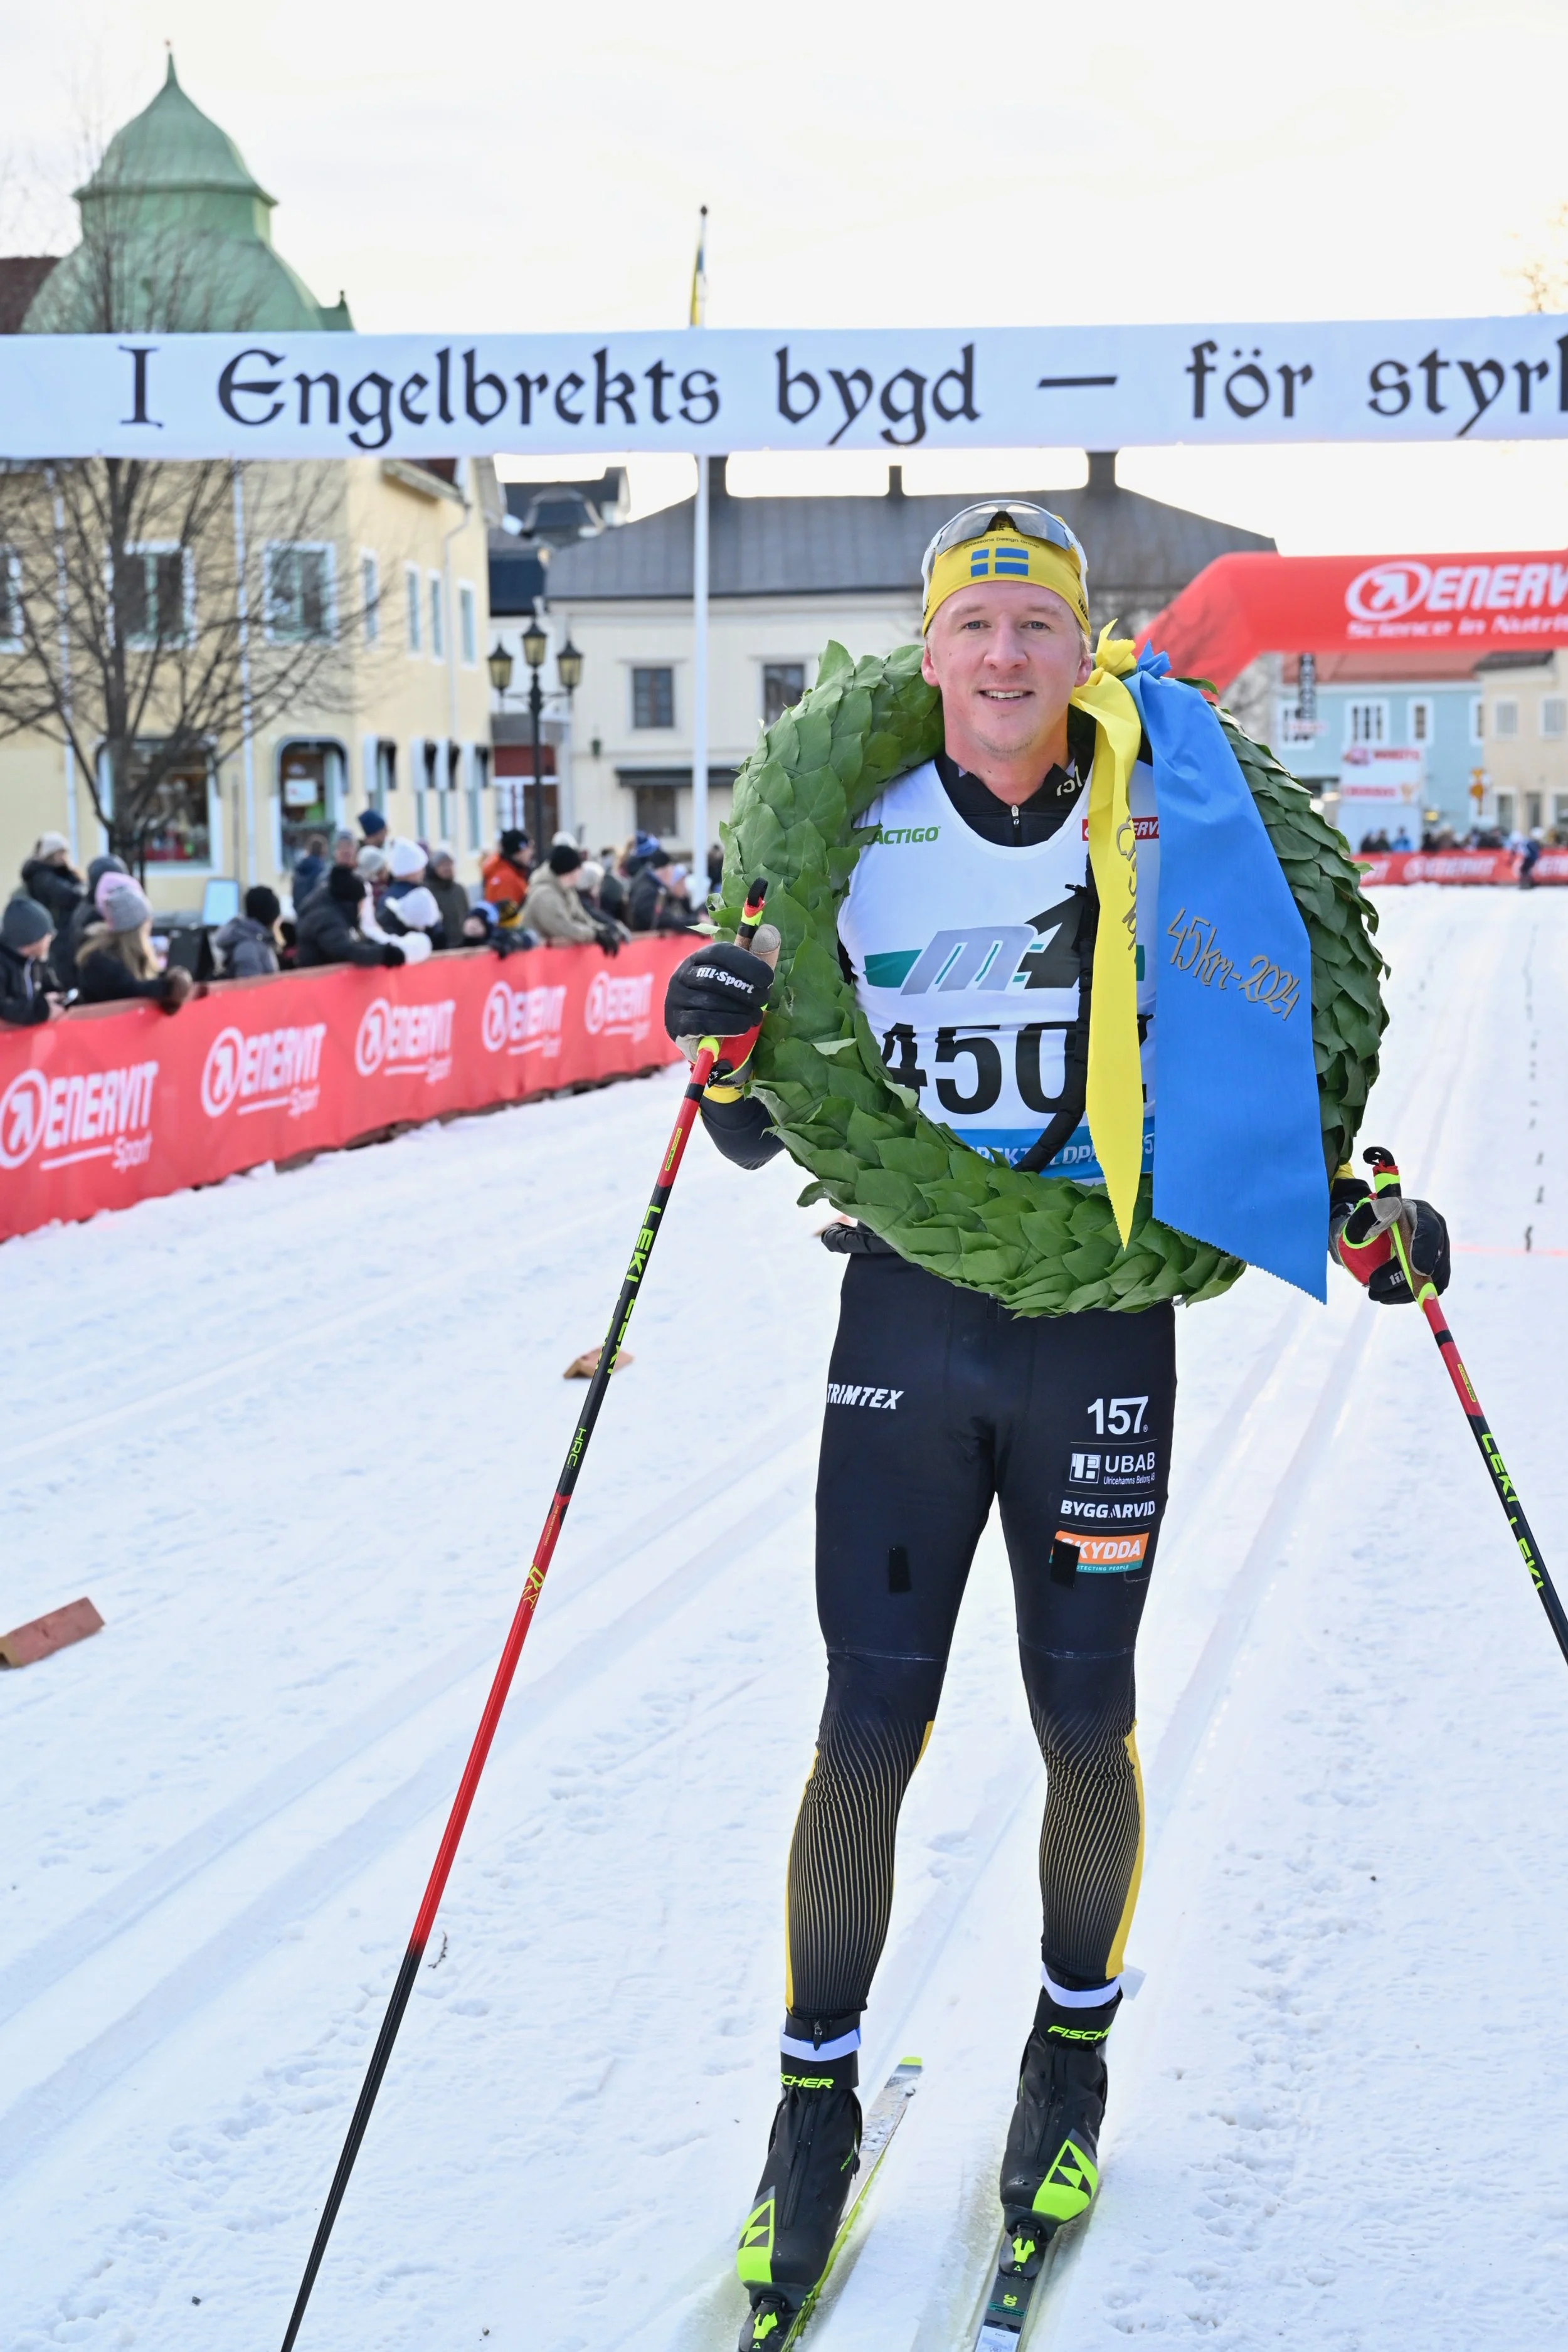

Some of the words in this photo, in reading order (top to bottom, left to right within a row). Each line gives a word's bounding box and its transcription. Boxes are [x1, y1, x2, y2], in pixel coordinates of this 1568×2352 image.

[118, 344, 164, 429] I
[217, 346, 721, 449] Engelbrekts
[774, 342, 981, 447] bygd
[1185, 339, 1314, 419] för
[386, 999, 456, 1060] ENERVIT
[240, 1022, 327, 1098] ENERVIT
[43, 1060, 159, 1149] ENERVIT
[112, 1131, 153, 1173] Sport
[625, 1205, 662, 1283] LEKI
[827, 1382, 905, 1410] TRIMTEX
[1087, 1396, 1149, 1435] 157
[566, 1428, 587, 1467] HRC
[1104, 1451, 1155, 1473] UBAB
[1481, 1433, 1518, 1503] LEKI
[1103, 1476, 1135, 1485] Ulricehamns
[1061, 1537, 1143, 1560] KYDDA
